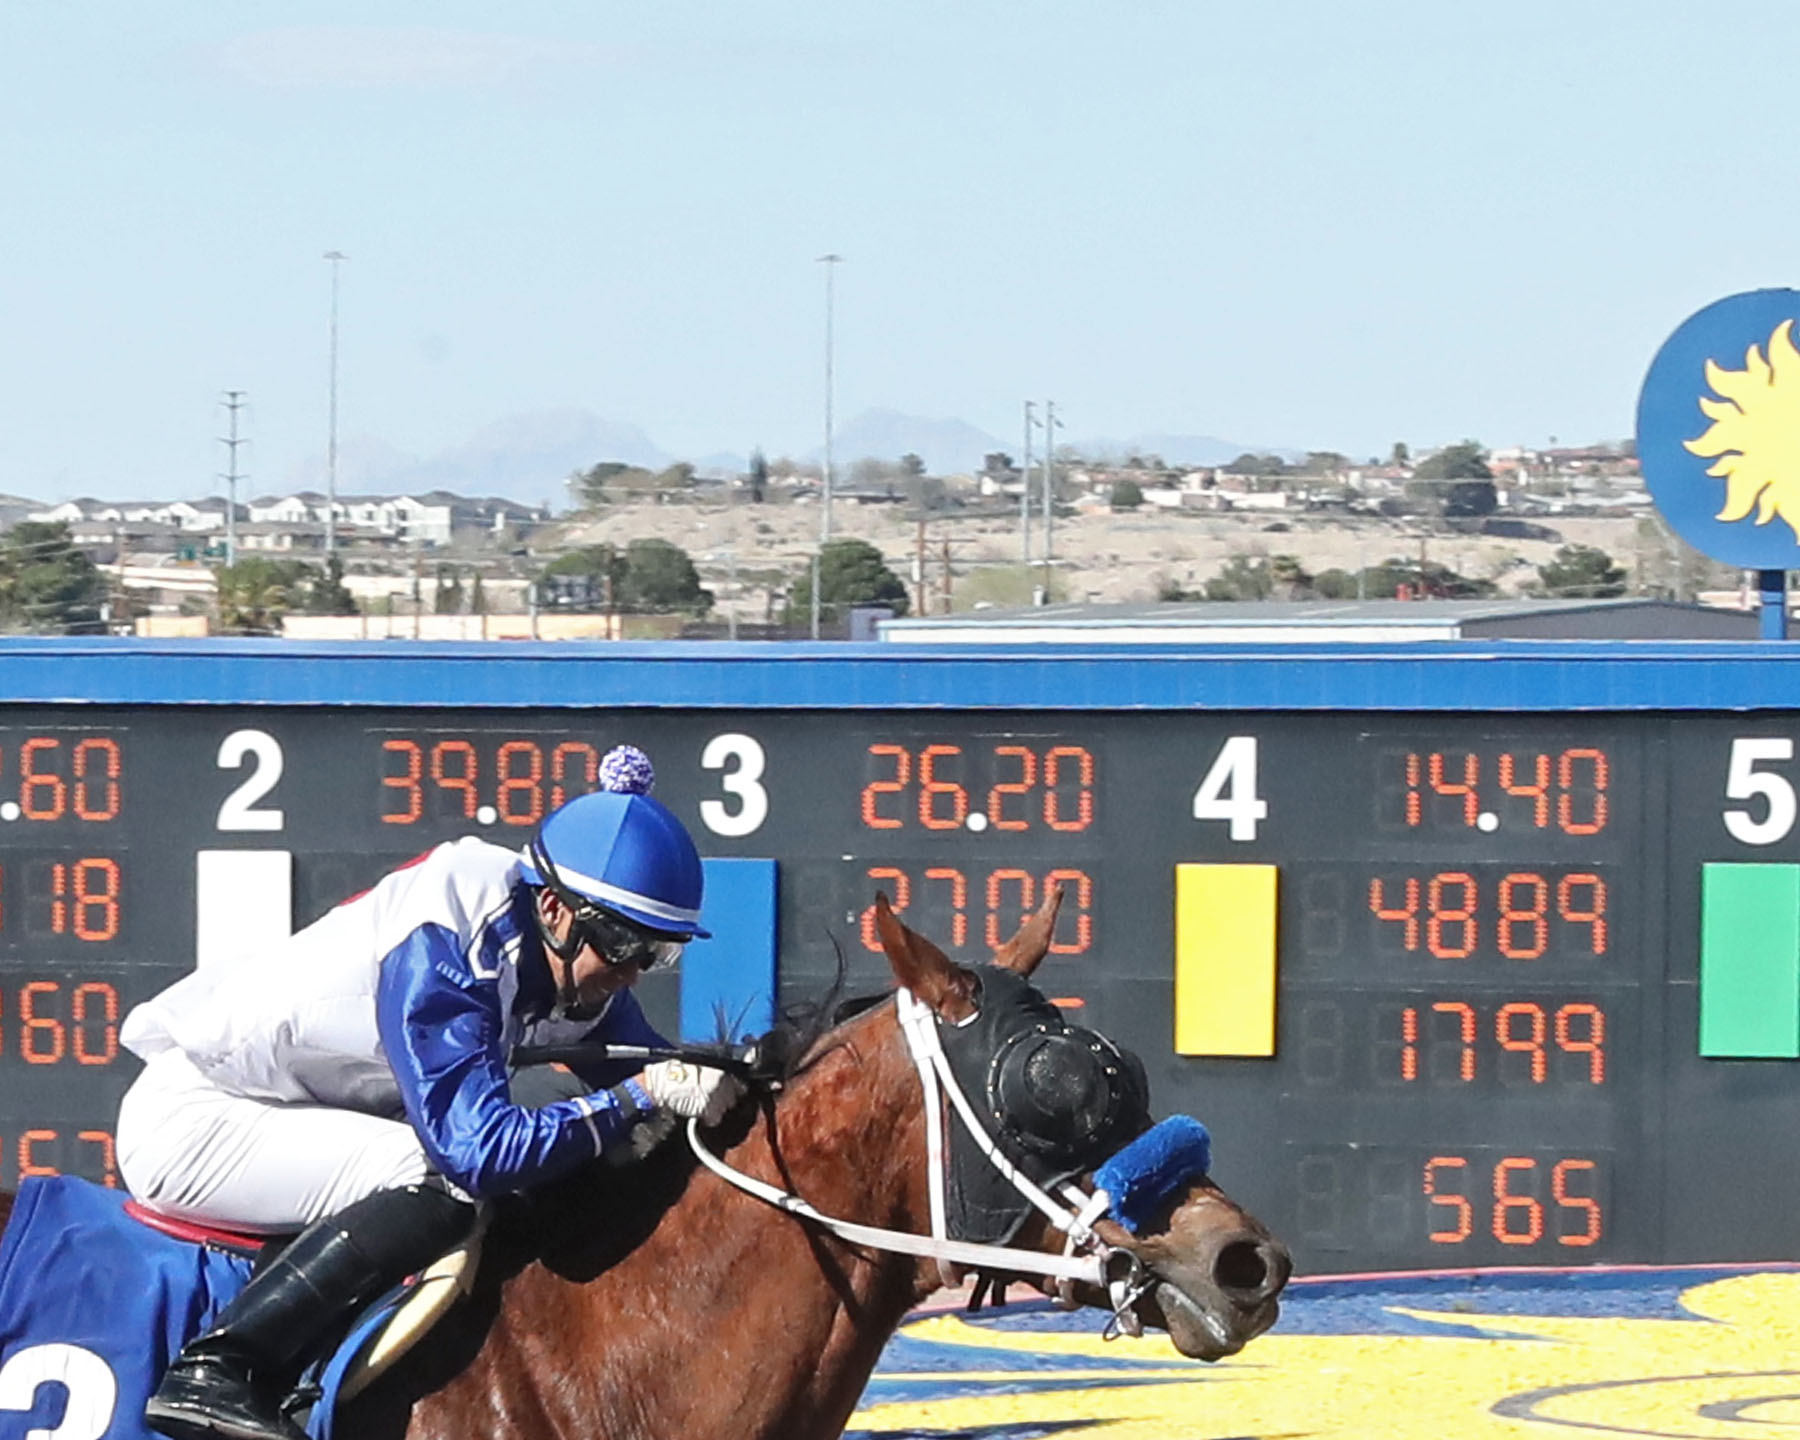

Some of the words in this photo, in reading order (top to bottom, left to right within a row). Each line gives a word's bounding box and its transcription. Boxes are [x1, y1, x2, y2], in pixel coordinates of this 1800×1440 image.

[217, 729, 284, 831] 2
[700, 733, 768, 837] 3
[860, 743, 1095, 833] 26.20
[1193, 736, 1268, 841] 4
[1406, 748, 1610, 836] 14.40
[1722, 738, 1797, 845] 5
[1369, 871, 1608, 960] 4889
[1400, 1001, 1606, 1085] 1799
[1423, 1156, 1602, 1247] 565
